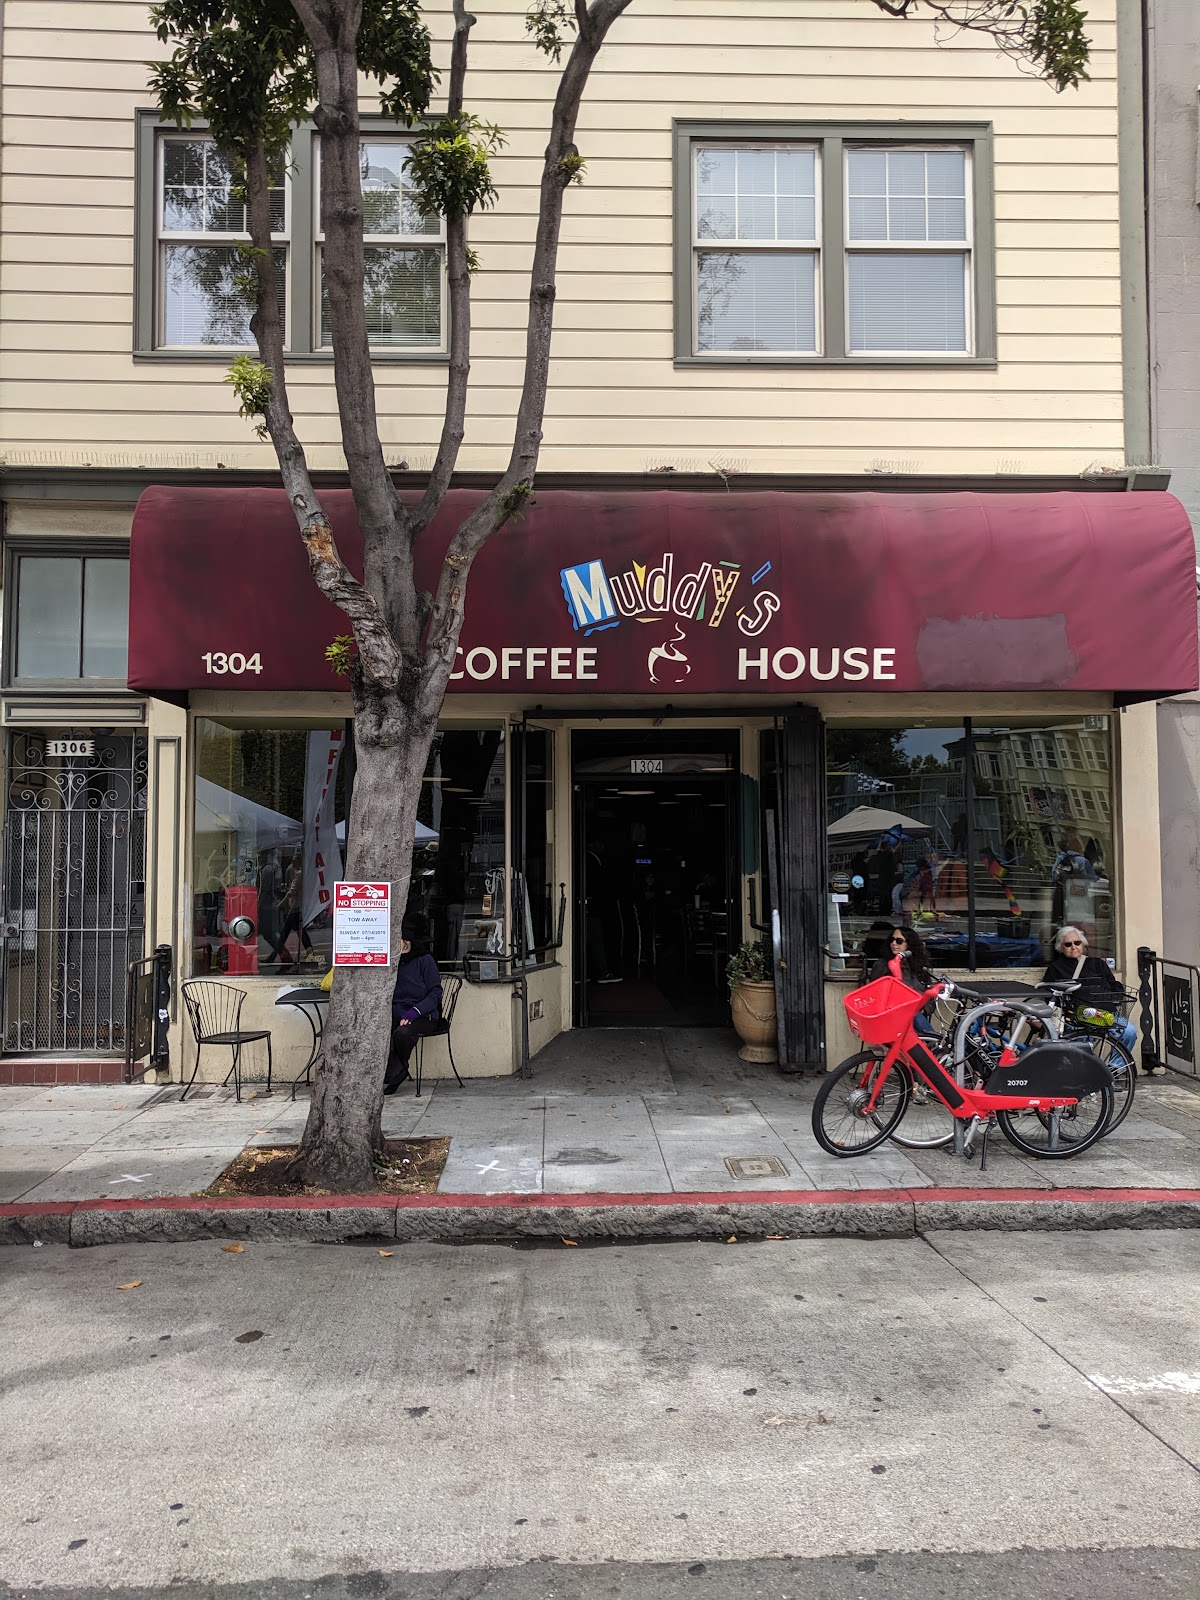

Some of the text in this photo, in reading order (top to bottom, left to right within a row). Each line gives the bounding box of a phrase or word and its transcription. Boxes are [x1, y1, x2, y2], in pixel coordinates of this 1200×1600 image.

[201, 652, 263, 675] 1304
[738, 647, 896, 681] HOUSE
[53, 742, 87, 754] 1306
[633, 760, 662, 773] 1304
[315, 852, 331, 905] AID
[338, 899, 386, 907] NO STOPPING
